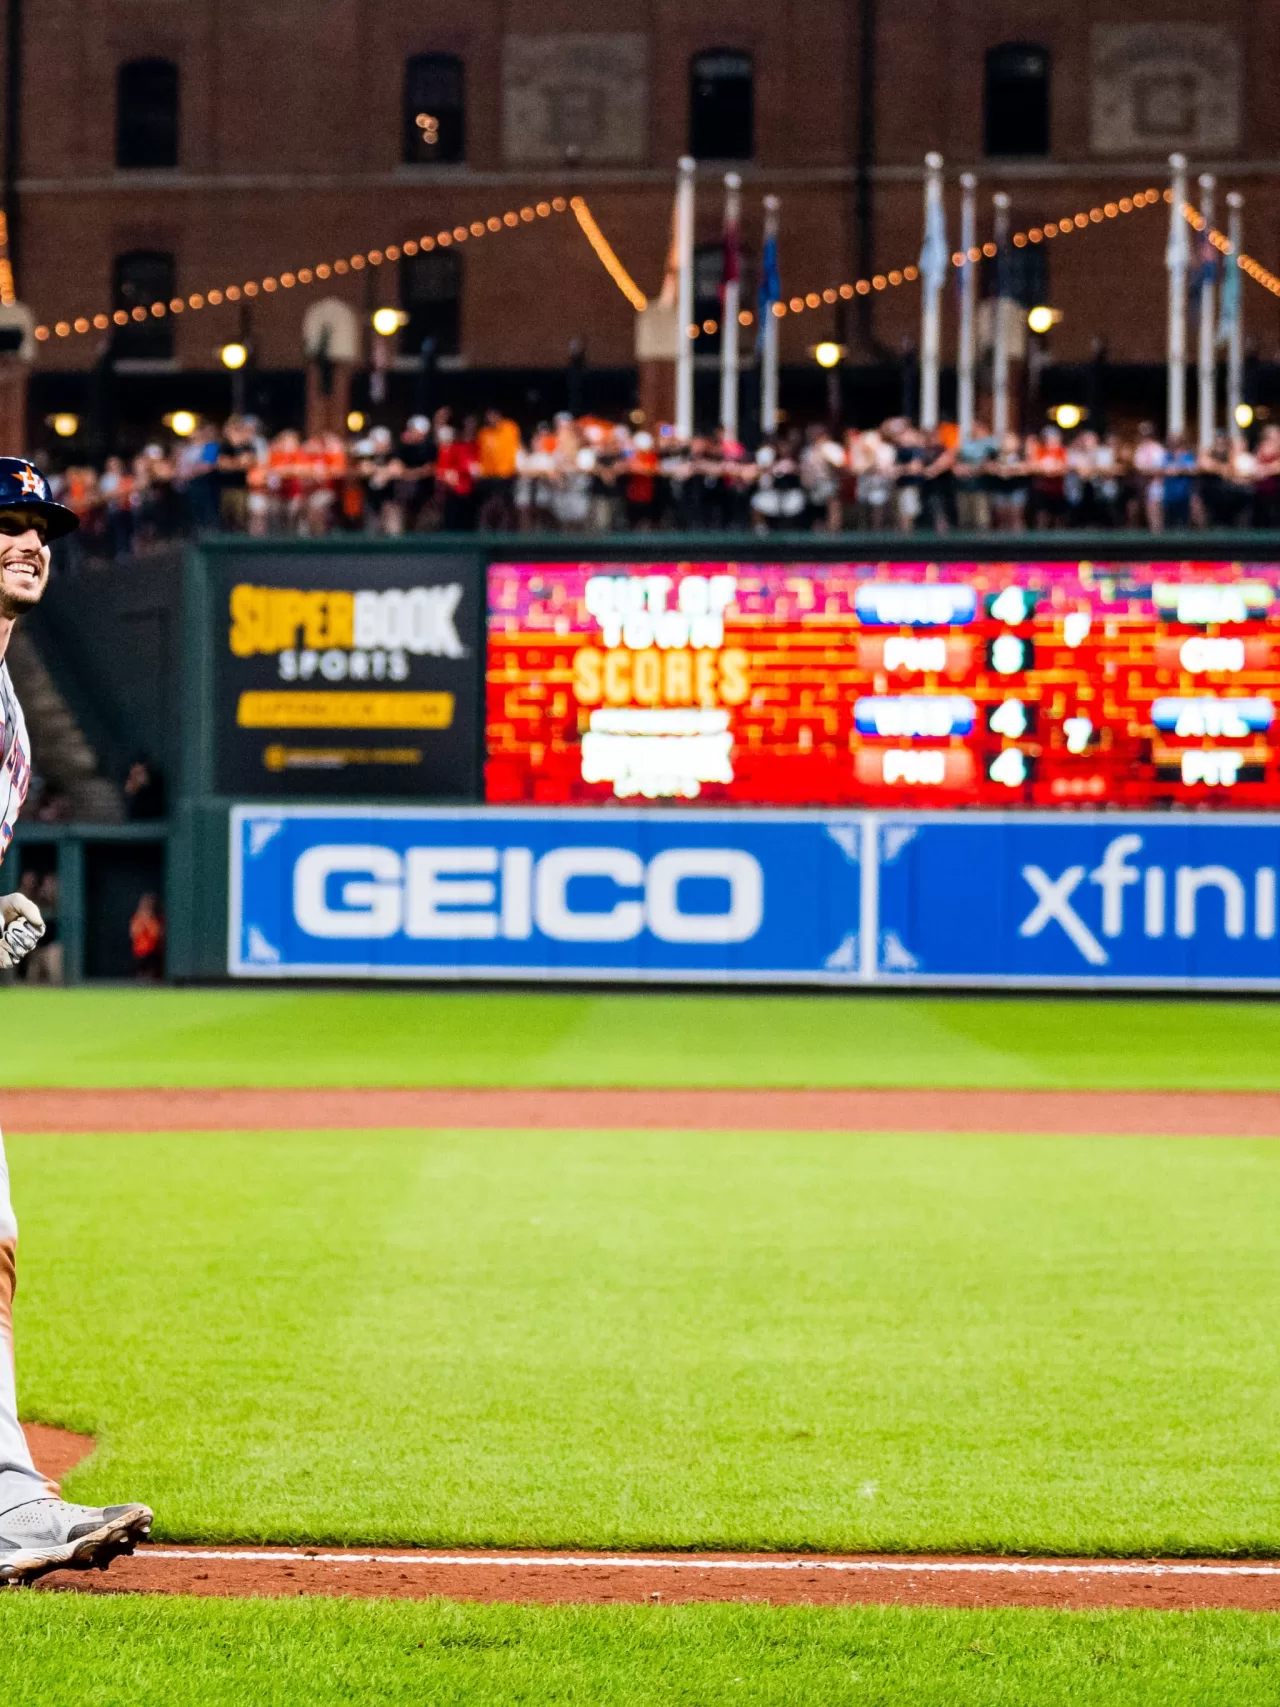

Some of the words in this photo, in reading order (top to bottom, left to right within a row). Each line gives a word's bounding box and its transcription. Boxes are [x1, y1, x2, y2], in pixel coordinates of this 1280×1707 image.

[585, 576, 672, 616] OUT
[678, 576, 737, 616] OF
[990, 586, 1027, 625] 4
[596, 611, 724, 649] TOWN
[278, 649, 410, 681] SPORTS
[572, 647, 751, 705] SCORES
[989, 698, 1027, 738] 4
[989, 747, 1027, 786] 4
[294, 845, 763, 943] GEICO
